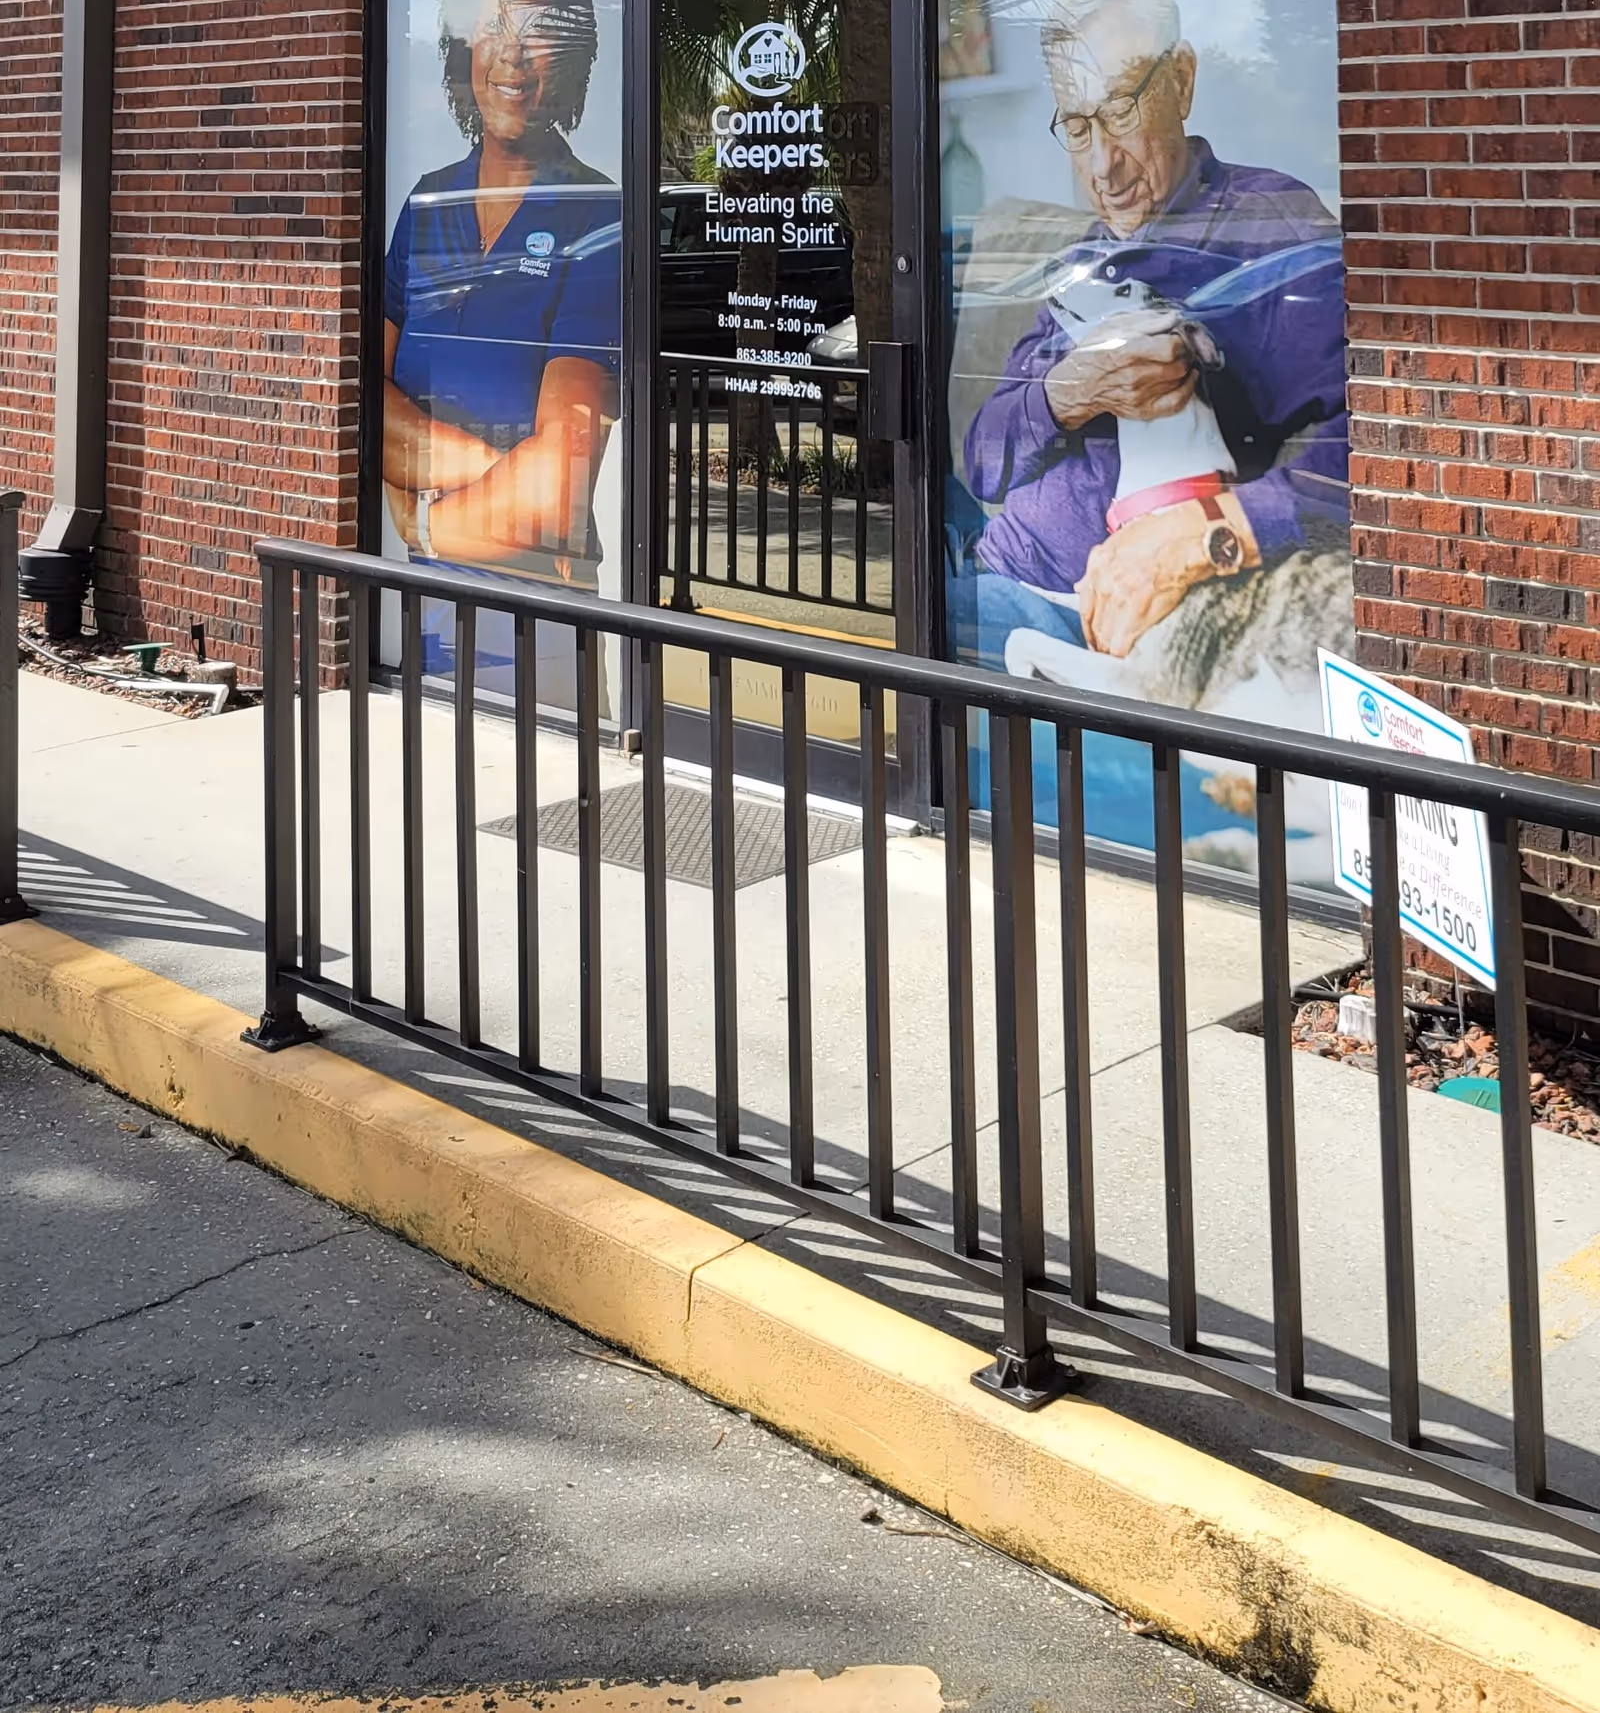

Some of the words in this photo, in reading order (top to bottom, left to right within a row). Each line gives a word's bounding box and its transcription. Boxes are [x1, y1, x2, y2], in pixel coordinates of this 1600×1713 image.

[711, 102, 824, 136] Comfort
[705, 192, 795, 219] Elevating
[801, 193, 834, 214] the
[705, 221, 775, 243] Human
[520, 258, 551, 270] Comfort
[728, 292, 771, 310] Monday
[781, 294, 818, 313] Friday
[718, 314, 741, 328] 8:00
[743, 318, 767, 330] a.m.
[776, 317, 801, 332] 5:00
[803, 320, 829, 336] p.m.
[736, 348, 811, 366] 863-385-9200
[724, 376, 758, 393] HHA#
[760, 380, 822, 400] 299992766
[1383, 705, 1425, 745] Comfort
[1353, 848, 1477, 952] 8593-1500
[1420, 865, 1482, 919] Difference
